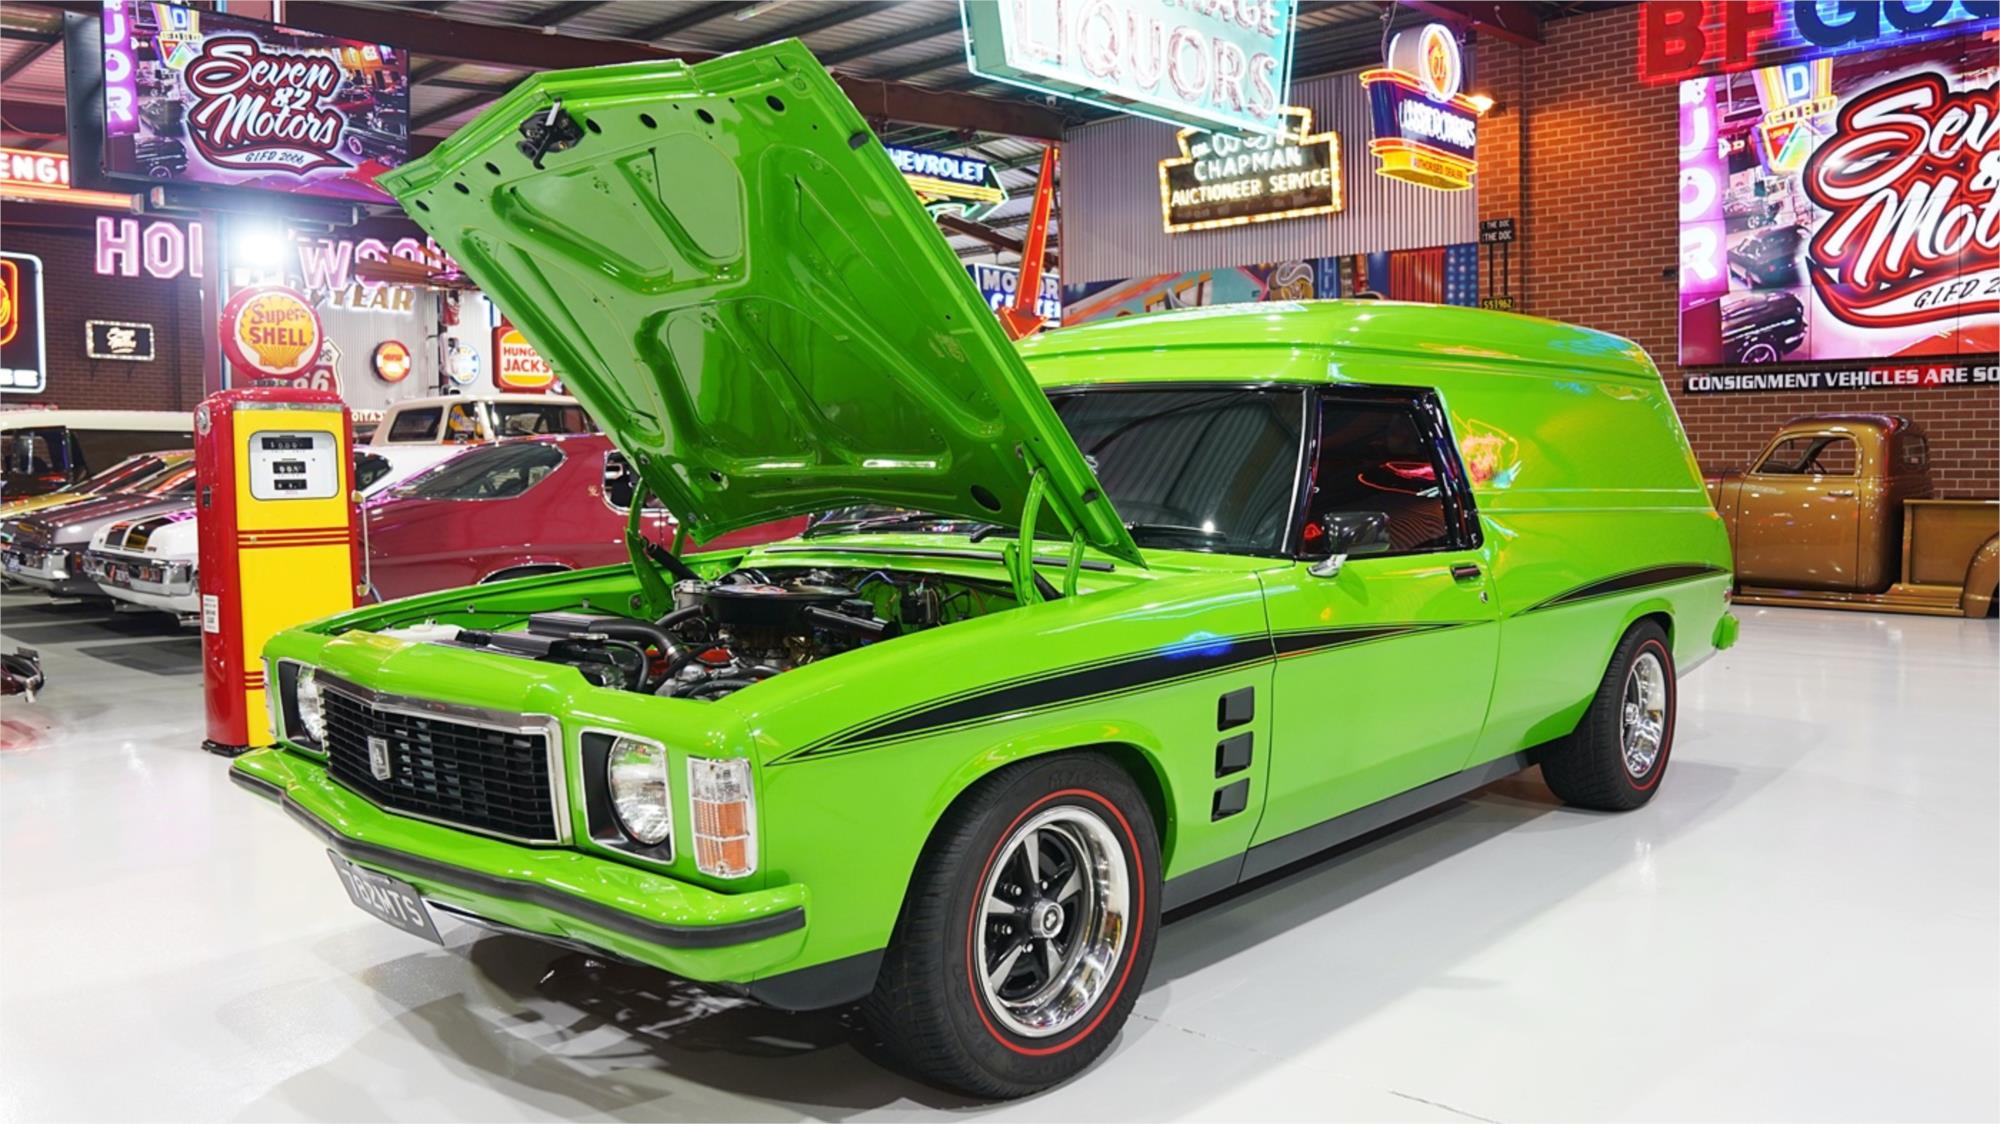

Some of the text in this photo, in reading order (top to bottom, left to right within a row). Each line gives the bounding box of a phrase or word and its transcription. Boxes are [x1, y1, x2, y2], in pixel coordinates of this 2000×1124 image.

[193, 44, 333, 94] Seven
[1012, 0, 1279, 120] LIQUORS
[271, 87, 311, 110] 82
[197, 93, 336, 144] Motors
[886, 147, 987, 182] HEVROLET
[1193, 145, 1303, 182] CHAPMAN
[1170, 178, 1264, 208] AUCTIONEER
[1268, 167, 1331, 193] SERVICE
[249, 326, 308, 347] SHELL
[1688, 372, 1821, 392] CONSIGNMENT
[1824, 369, 1918, 388] VEHICLES
[1924, 367, 1968, 384] ARE
